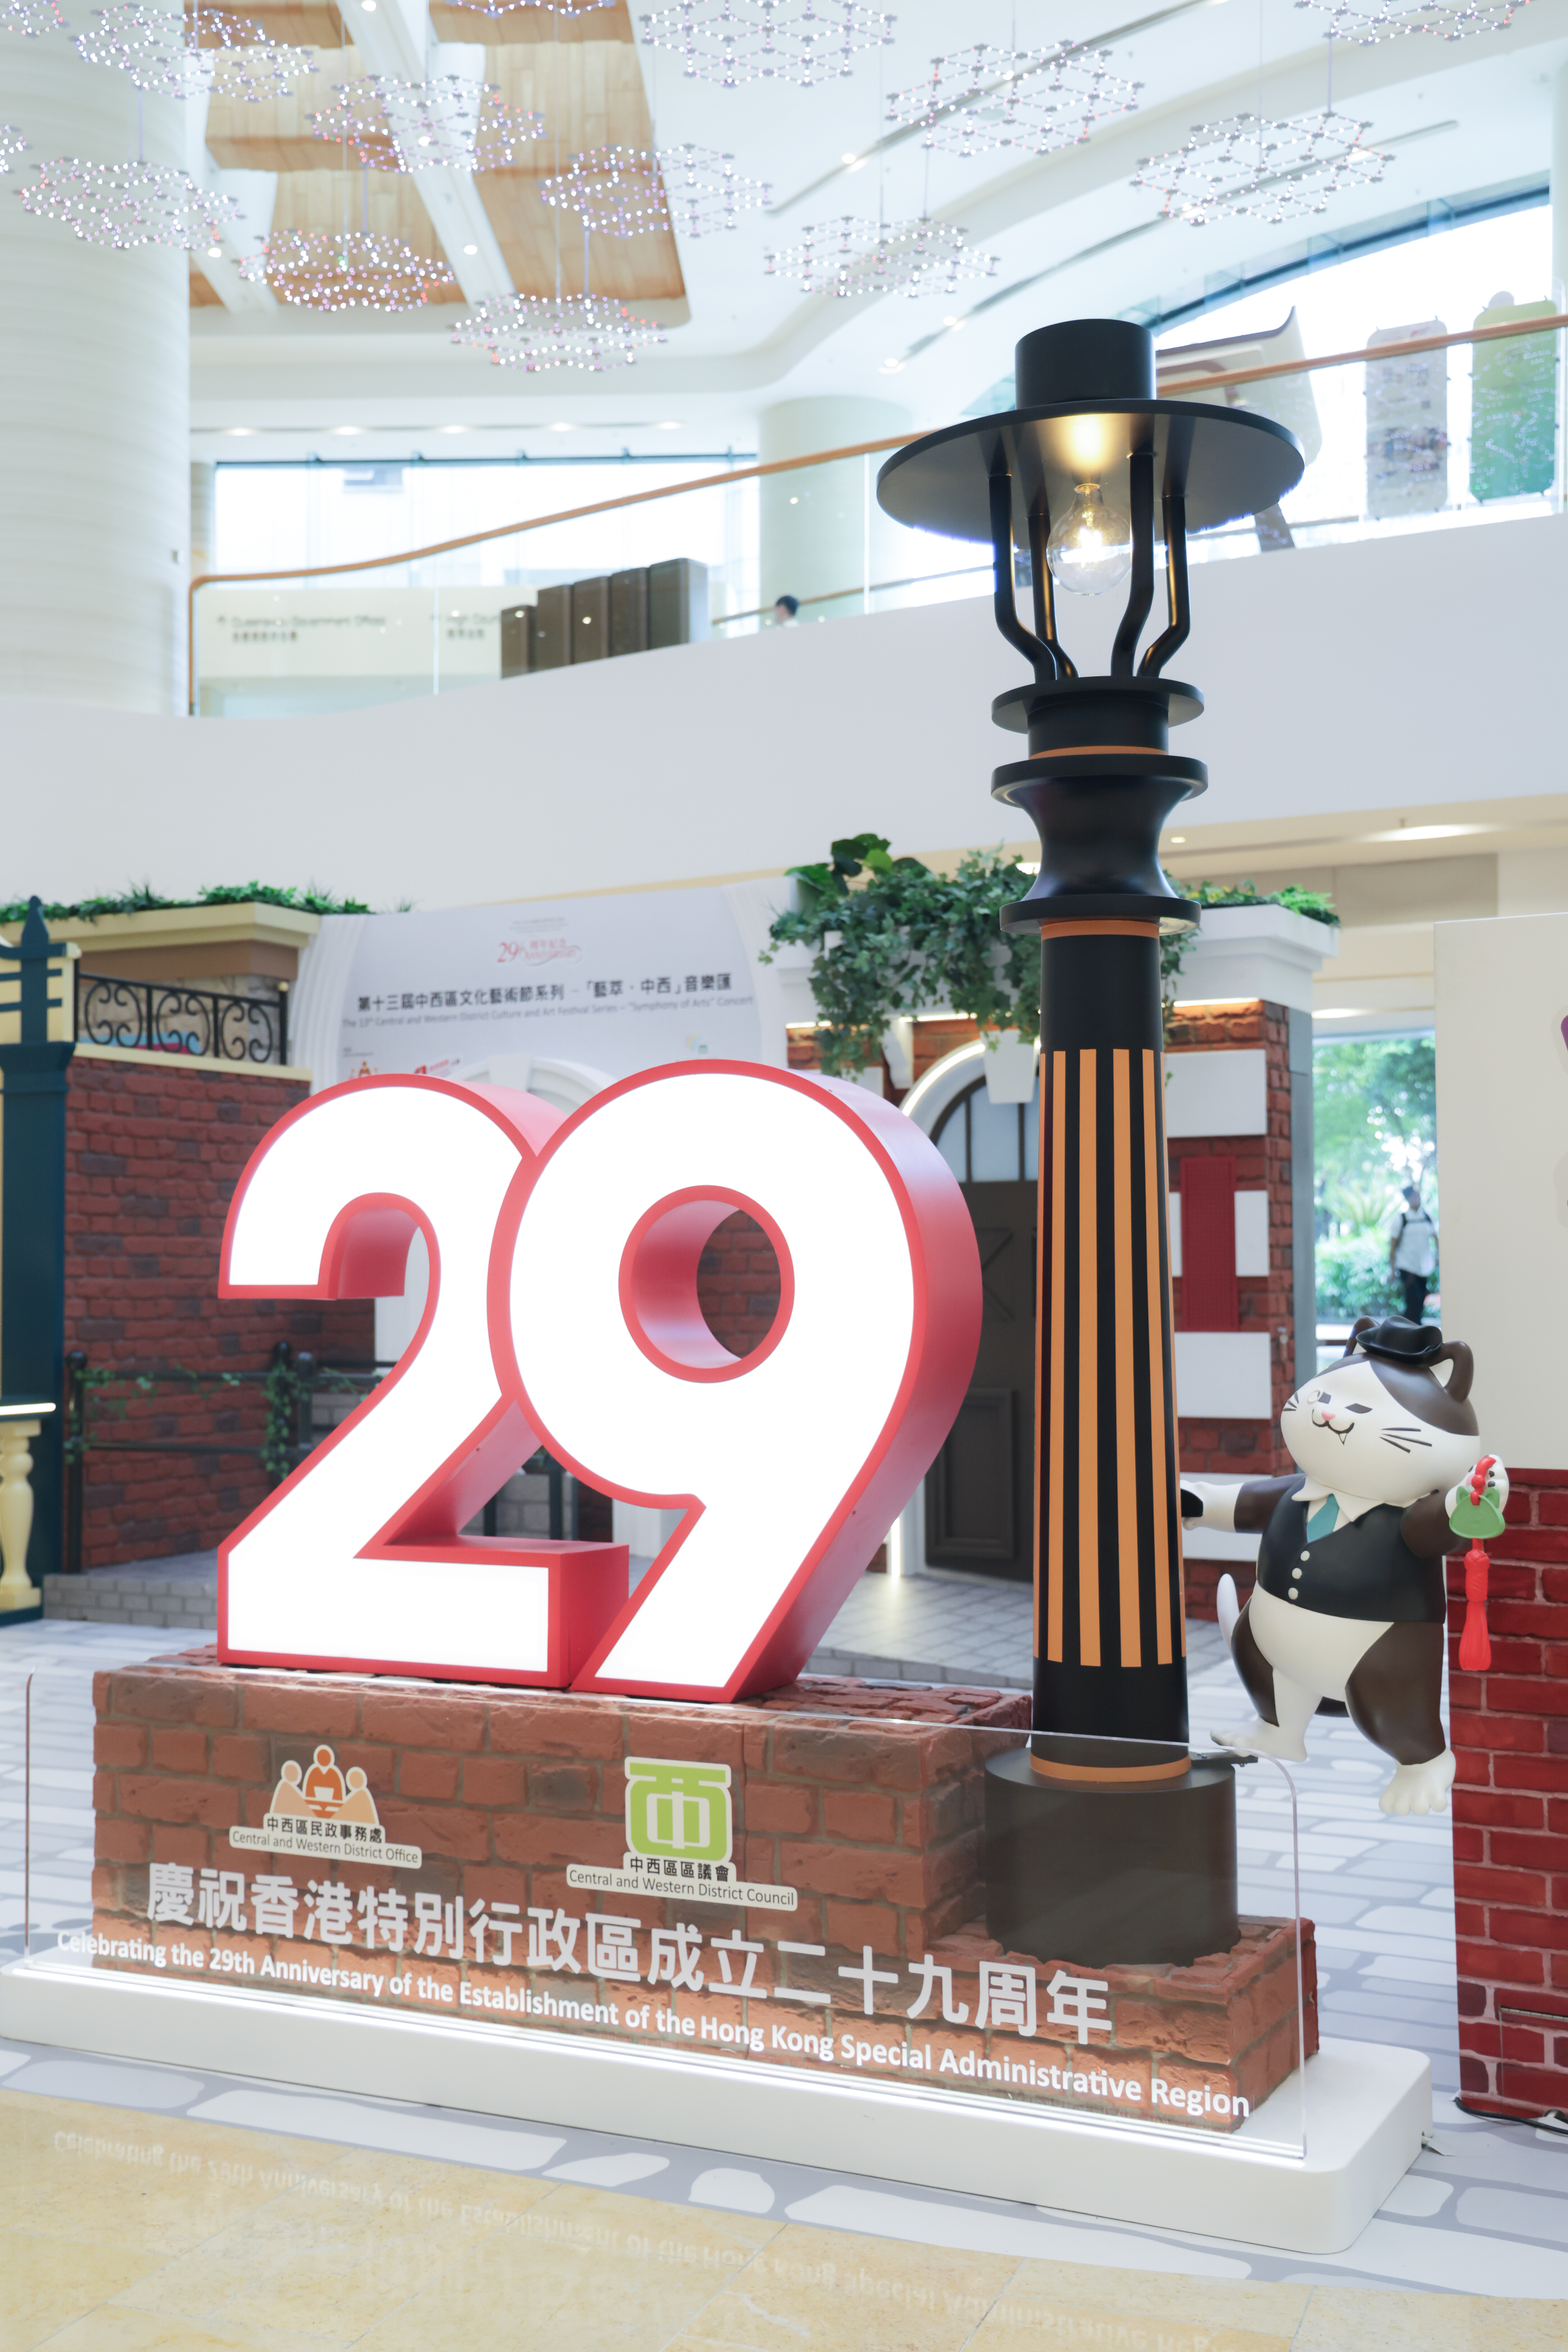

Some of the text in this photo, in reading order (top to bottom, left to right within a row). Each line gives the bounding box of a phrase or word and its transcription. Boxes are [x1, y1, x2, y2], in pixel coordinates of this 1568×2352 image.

[218, 1059, 957, 1705] 29
[233, 1830, 418, 1864] Central and Western District Office
[267, 1816, 382, 1843] 中西區民政事務處
[569, 1869, 794, 1906] Central and Western District Council
[630, 1856, 729, 1882] 中西區區議會
[146, 1862, 1112, 2044] 慶祝香港特別行政區成立二十九周年
[57, 1930, 1250, 2117] Celebrating the 29th Anniversary of the Establishment of the Hong Kong Special Administrative Region
